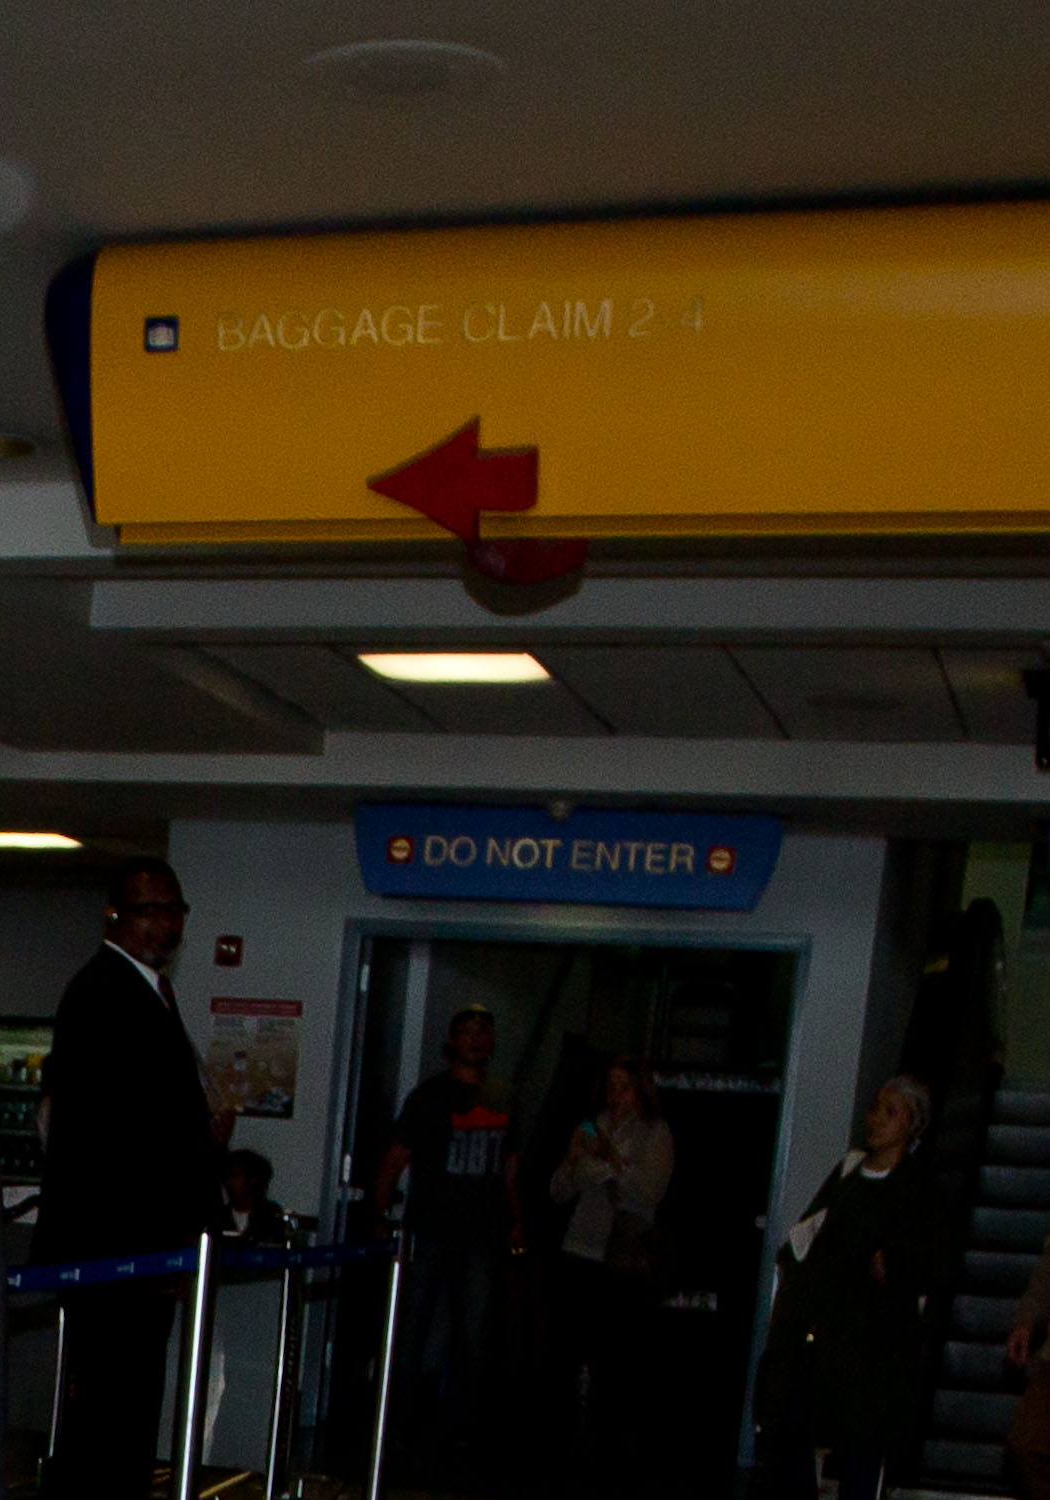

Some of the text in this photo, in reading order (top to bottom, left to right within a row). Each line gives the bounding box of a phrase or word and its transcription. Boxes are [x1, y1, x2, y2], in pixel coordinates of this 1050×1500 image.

[217, 304, 443, 351] BAGGAGE
[463, 299, 614, 344] CLAIM
[423, 834, 695, 874] DO NOT ENTER
